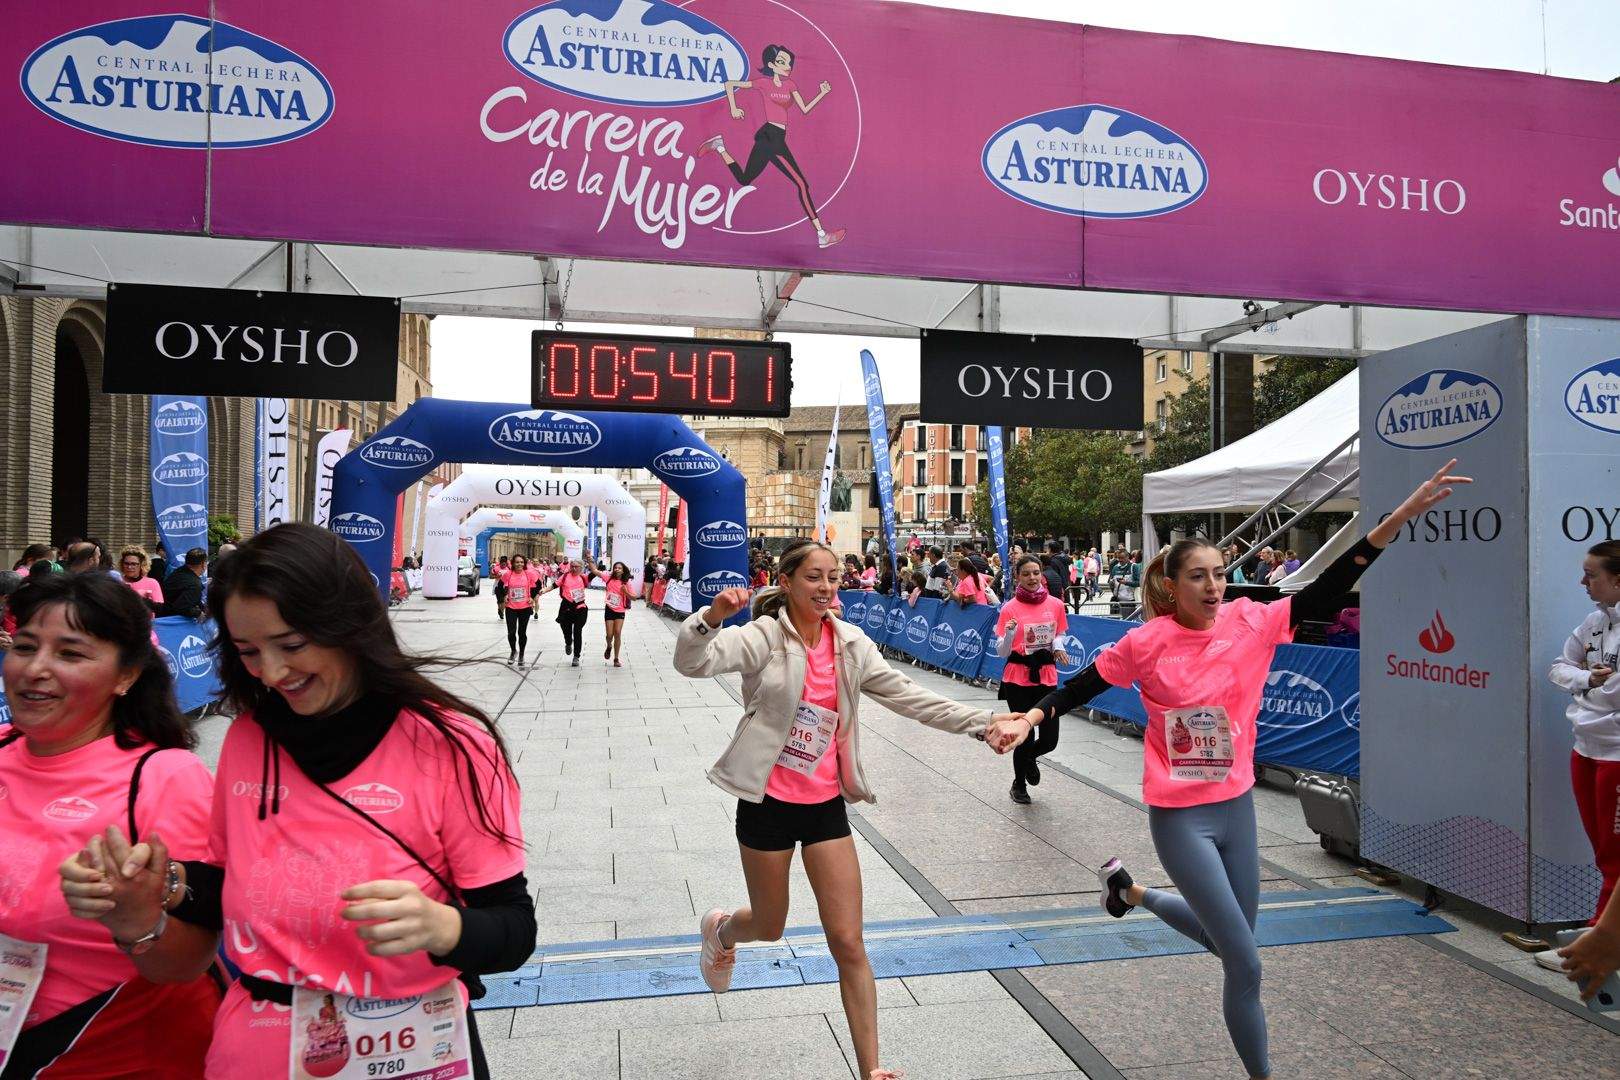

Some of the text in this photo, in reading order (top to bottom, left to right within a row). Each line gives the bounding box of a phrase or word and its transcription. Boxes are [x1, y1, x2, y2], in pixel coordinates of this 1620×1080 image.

[562, 25, 724, 51] CENTRAL LECHERA
[97, 55, 302, 82] CENTRAL LECHERA
[523, 25, 730, 83] ASTURIANA
[45, 54, 312, 121] ASTURIANA
[480, 86, 685, 160] Carrera
[1036, 139, 1185, 161] CENTRAL LECHERA
[1000, 140, 1192, 194] ASTURIANA
[530, 151, 757, 249] de la Mujer
[1312, 168, 1466, 215] OYSHO
[1559, 198, 1620, 230] Sant
[155, 320, 359, 368] OYSHO
[957, 364, 1113, 402] OYSHO
[1597, 382, 1620, 391] CEN
[1400, 388, 1487, 410] CENTRAL LECHERA
[1575, 383, 1620, 414] AST
[515, 421, 551, 430] CENTRAL
[1384, 399, 1492, 436] ASTURIANA
[497, 421, 593, 445] ASTURIANA
[364, 446, 428, 462] ASTURIANA
[659, 458, 717, 470] ASTURIANA
[495, 477, 582, 497] OYSHO
[1561, 506, 1620, 541] OY
[1386, 653, 1491, 689] Santander
[790, 726, 813, 742] 016
[1194, 736, 1217, 747] 016
[354, 1027, 416, 1057] 016
[367, 1058, 405, 1076] 9780
